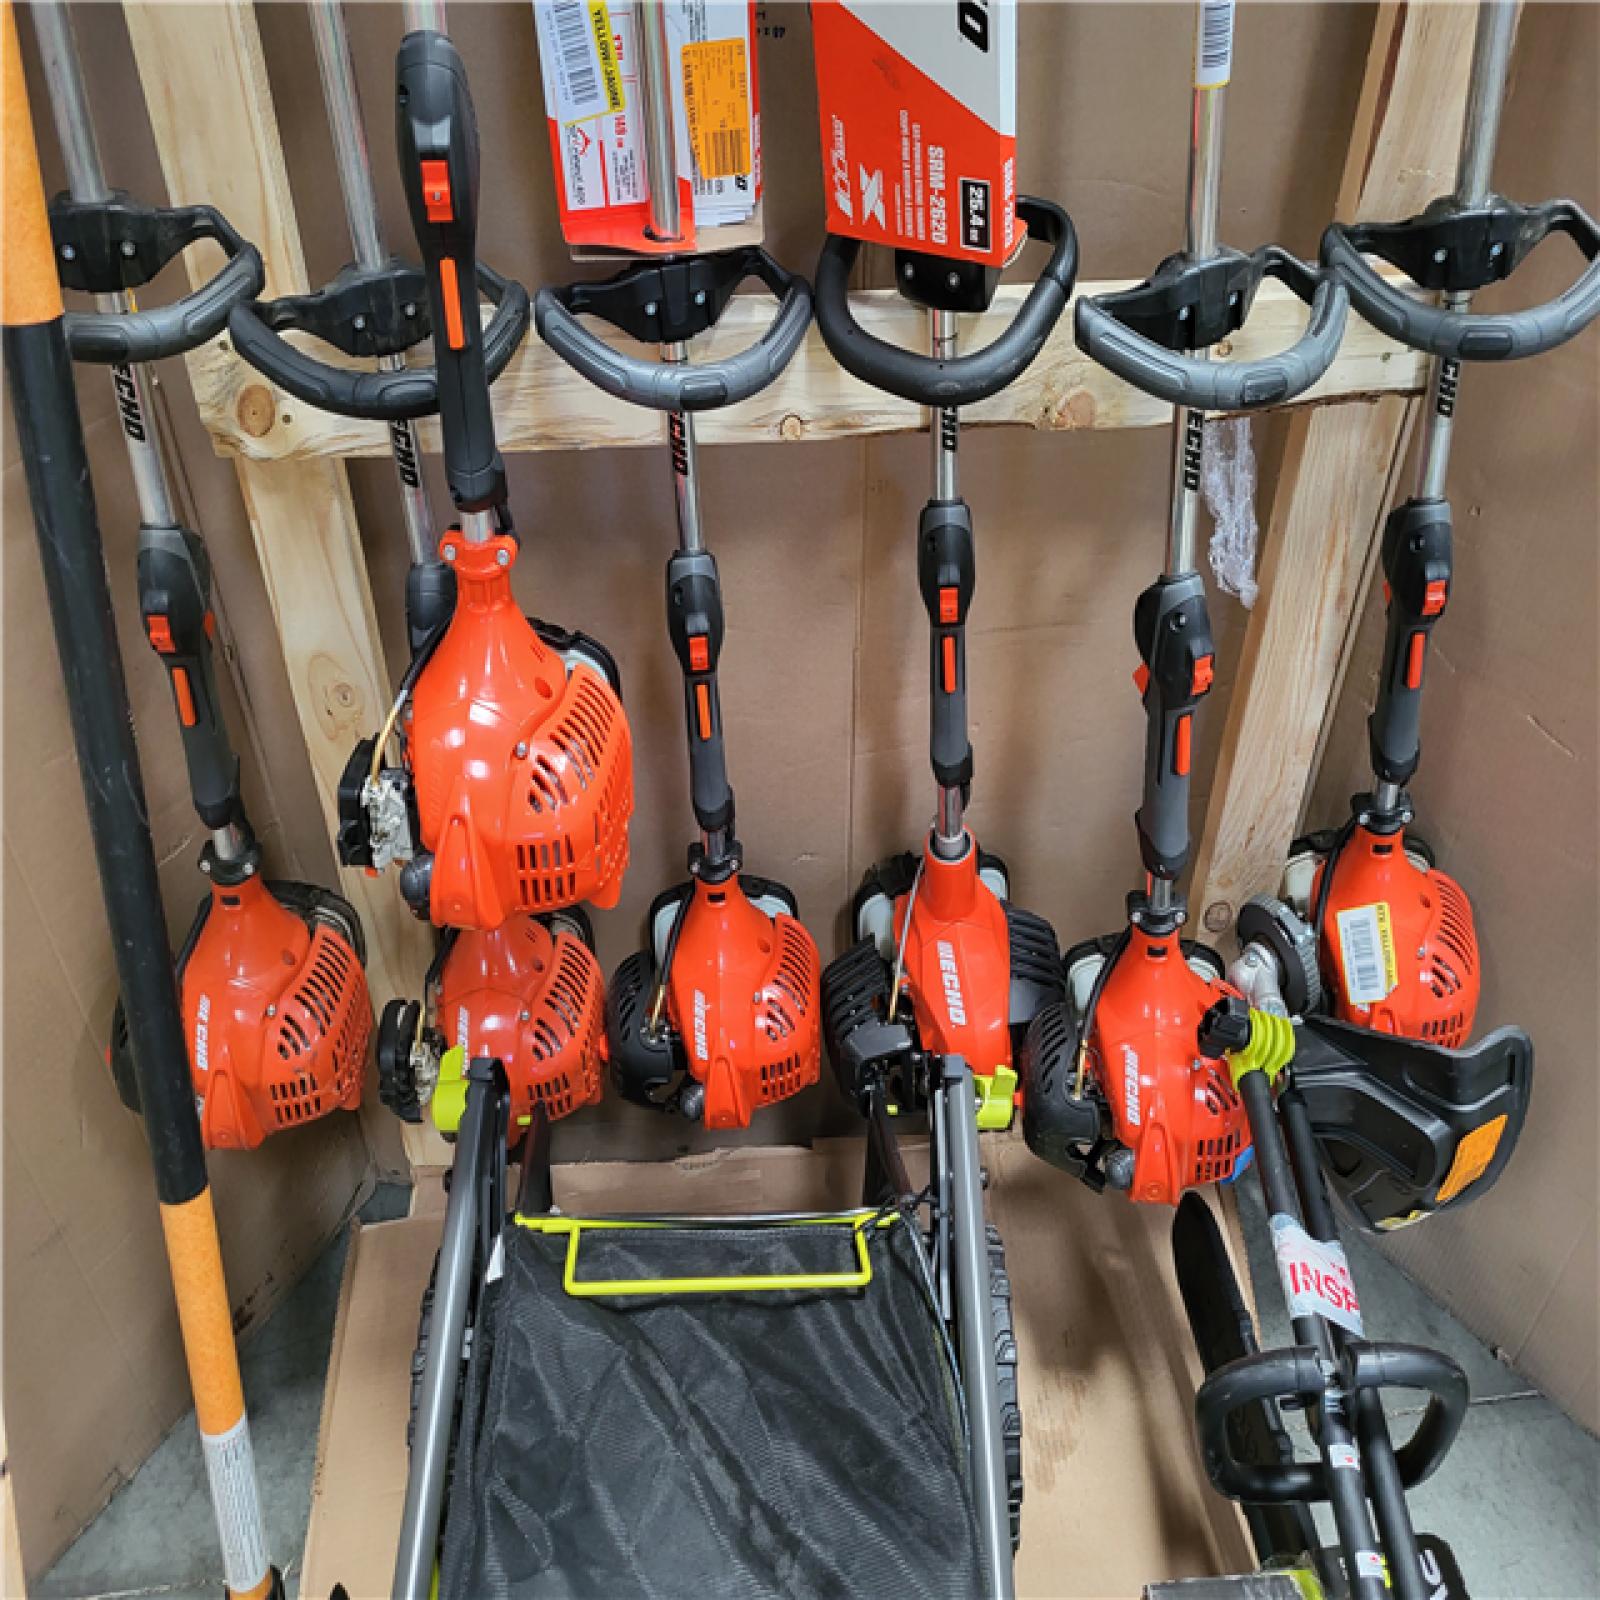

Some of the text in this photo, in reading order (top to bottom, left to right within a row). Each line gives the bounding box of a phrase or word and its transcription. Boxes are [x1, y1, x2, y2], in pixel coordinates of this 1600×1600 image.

[928, 144, 948, 244] SRM-2620
[1437, 357, 1460, 417] CHO
[1185, 409, 1203, 491] ECHO
[940, 958, 967, 1026] ECHO
[1125, 1063, 1141, 1126] ECHO
